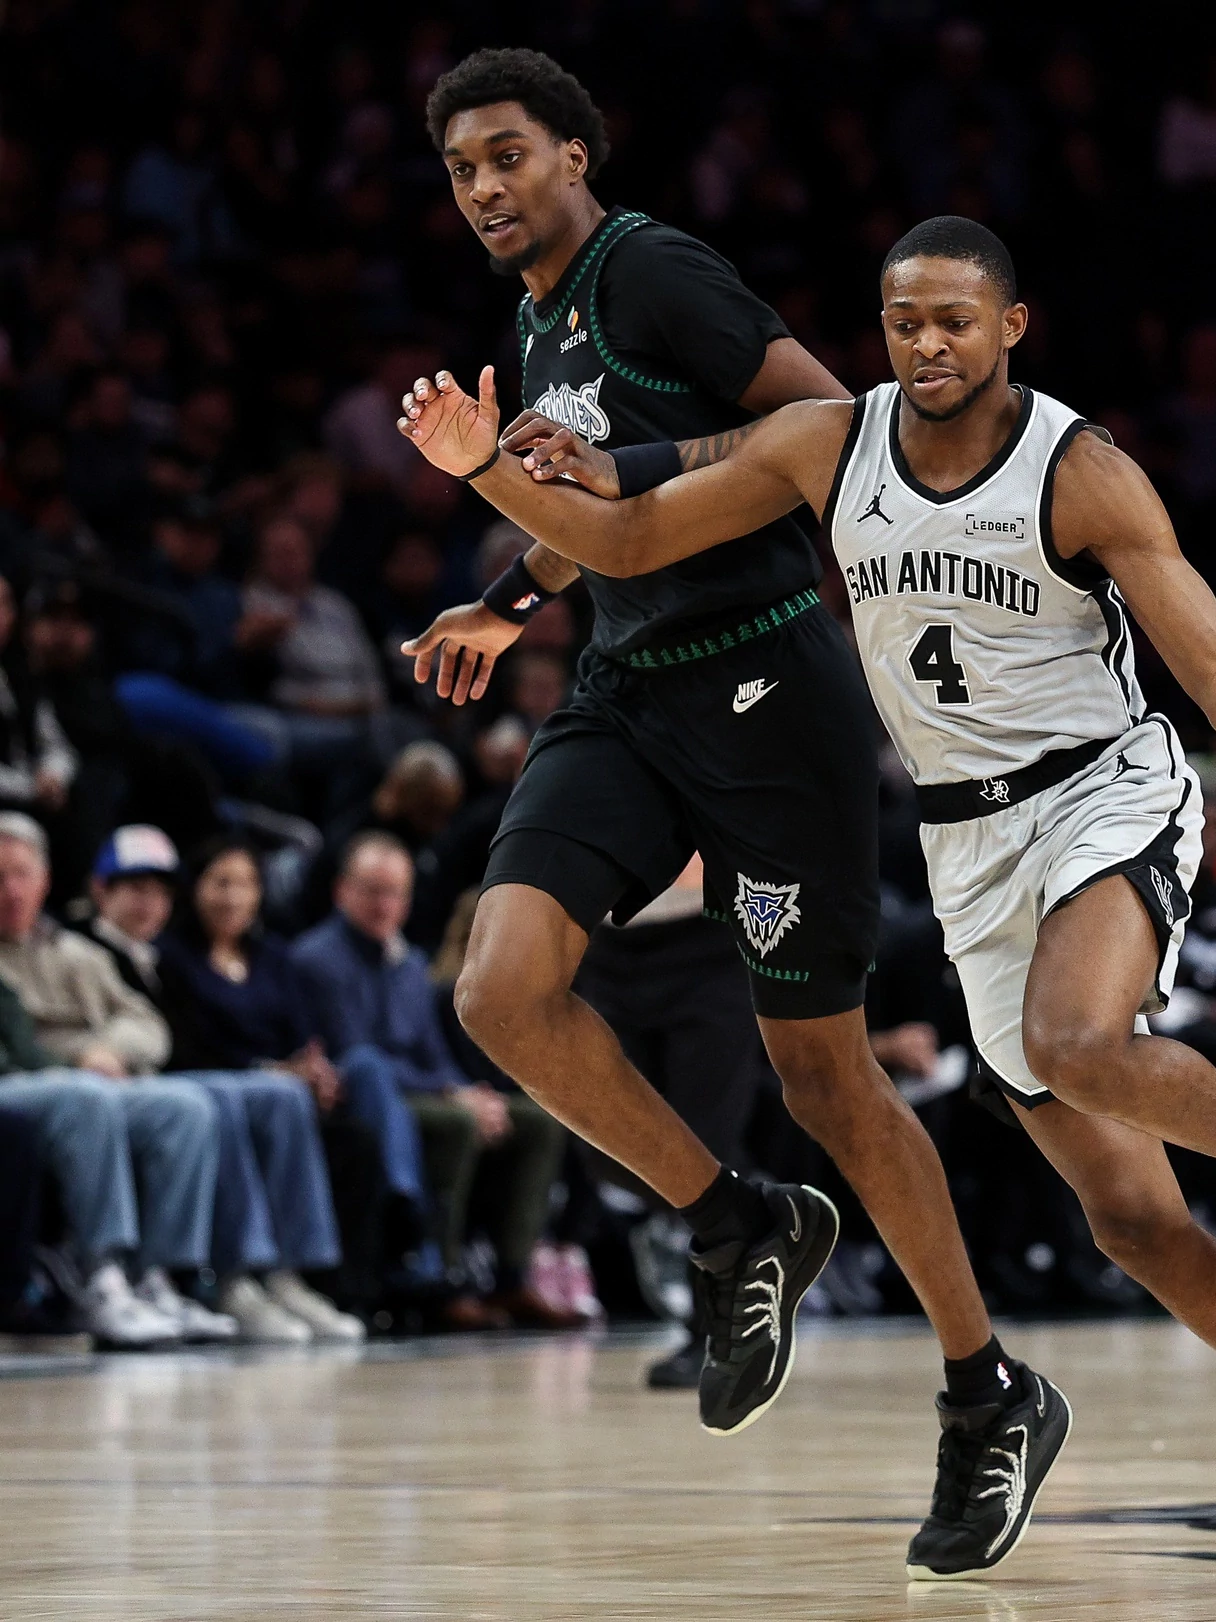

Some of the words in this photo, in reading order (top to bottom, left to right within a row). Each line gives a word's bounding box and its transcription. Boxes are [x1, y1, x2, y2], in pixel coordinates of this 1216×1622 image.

[560, 328, 587, 354] sezzle
[972, 520, 1018, 533] LEDGER
[846, 554, 889, 605] SAN
[896, 549, 1041, 618] ANTONIO
[906, 623, 972, 706] 4
[738, 678, 765, 701] NIKE
